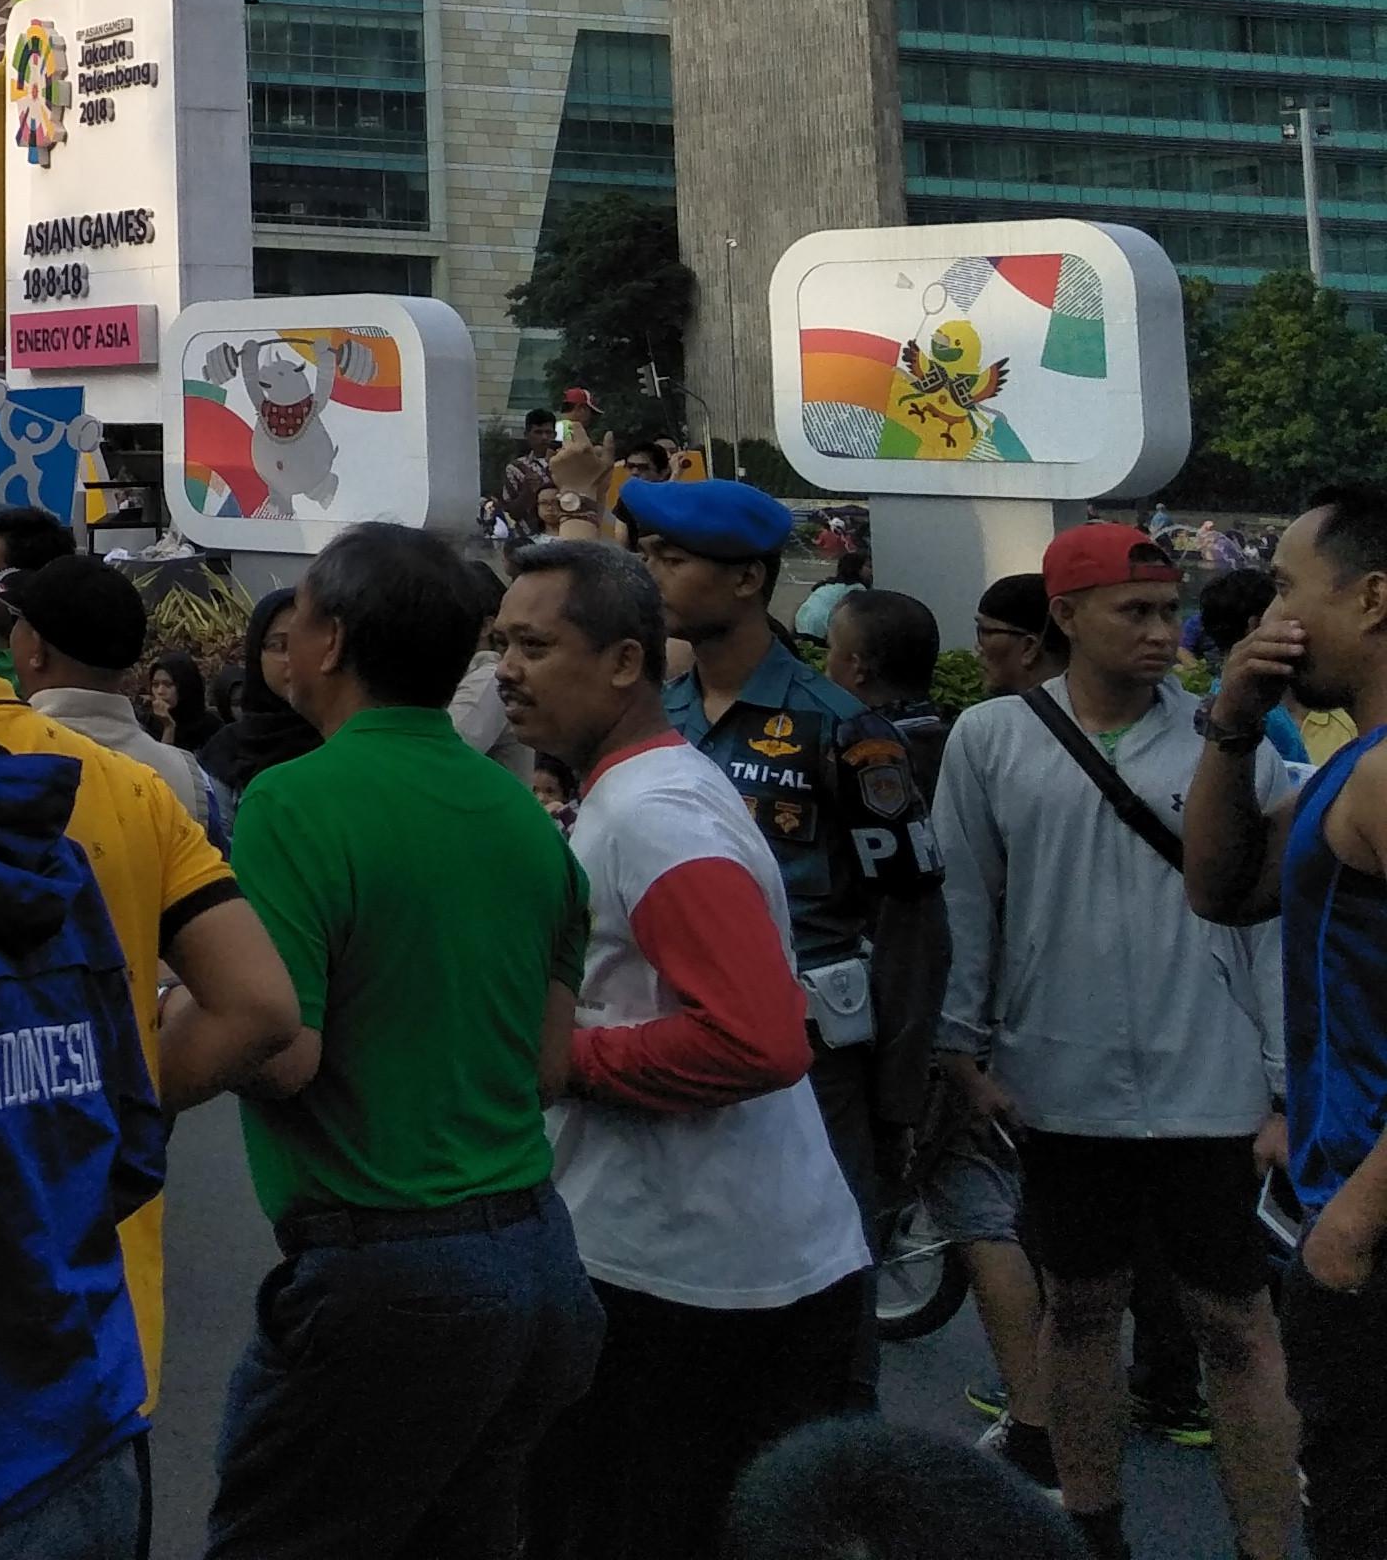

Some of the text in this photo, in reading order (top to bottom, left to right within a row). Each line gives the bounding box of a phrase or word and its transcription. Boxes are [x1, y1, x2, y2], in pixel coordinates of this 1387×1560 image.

[78, 40, 127, 68] Jakarta
[78, 62, 151, 96] Palembang
[79, 97, 108, 124] 2018
[24, 208, 148, 257] ASIAN GAMES
[16, 322, 131, 354] ENERGY OF ASIA
[730, 760, 813, 791] TNI-AL
